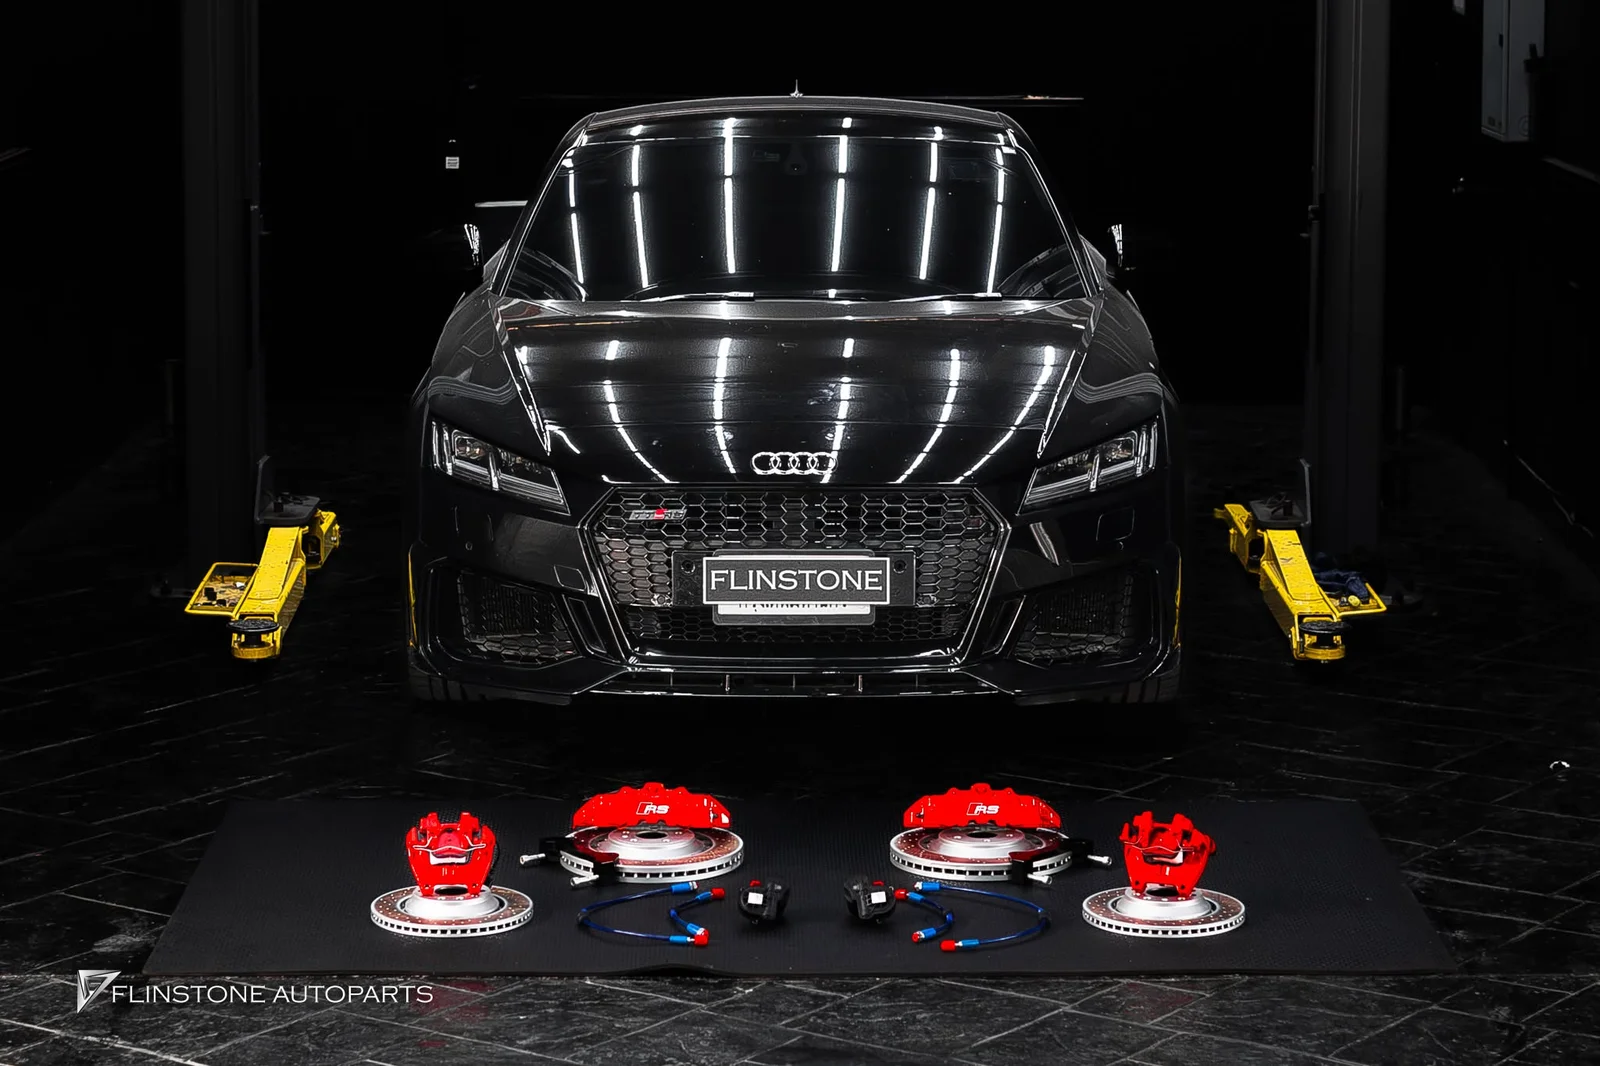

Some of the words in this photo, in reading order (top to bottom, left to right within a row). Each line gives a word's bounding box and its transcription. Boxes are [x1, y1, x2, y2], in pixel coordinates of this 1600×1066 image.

[710, 570, 883, 591] FLINSTONE
[643, 804, 670, 814] RS
[973, 805, 1000, 815] RS
